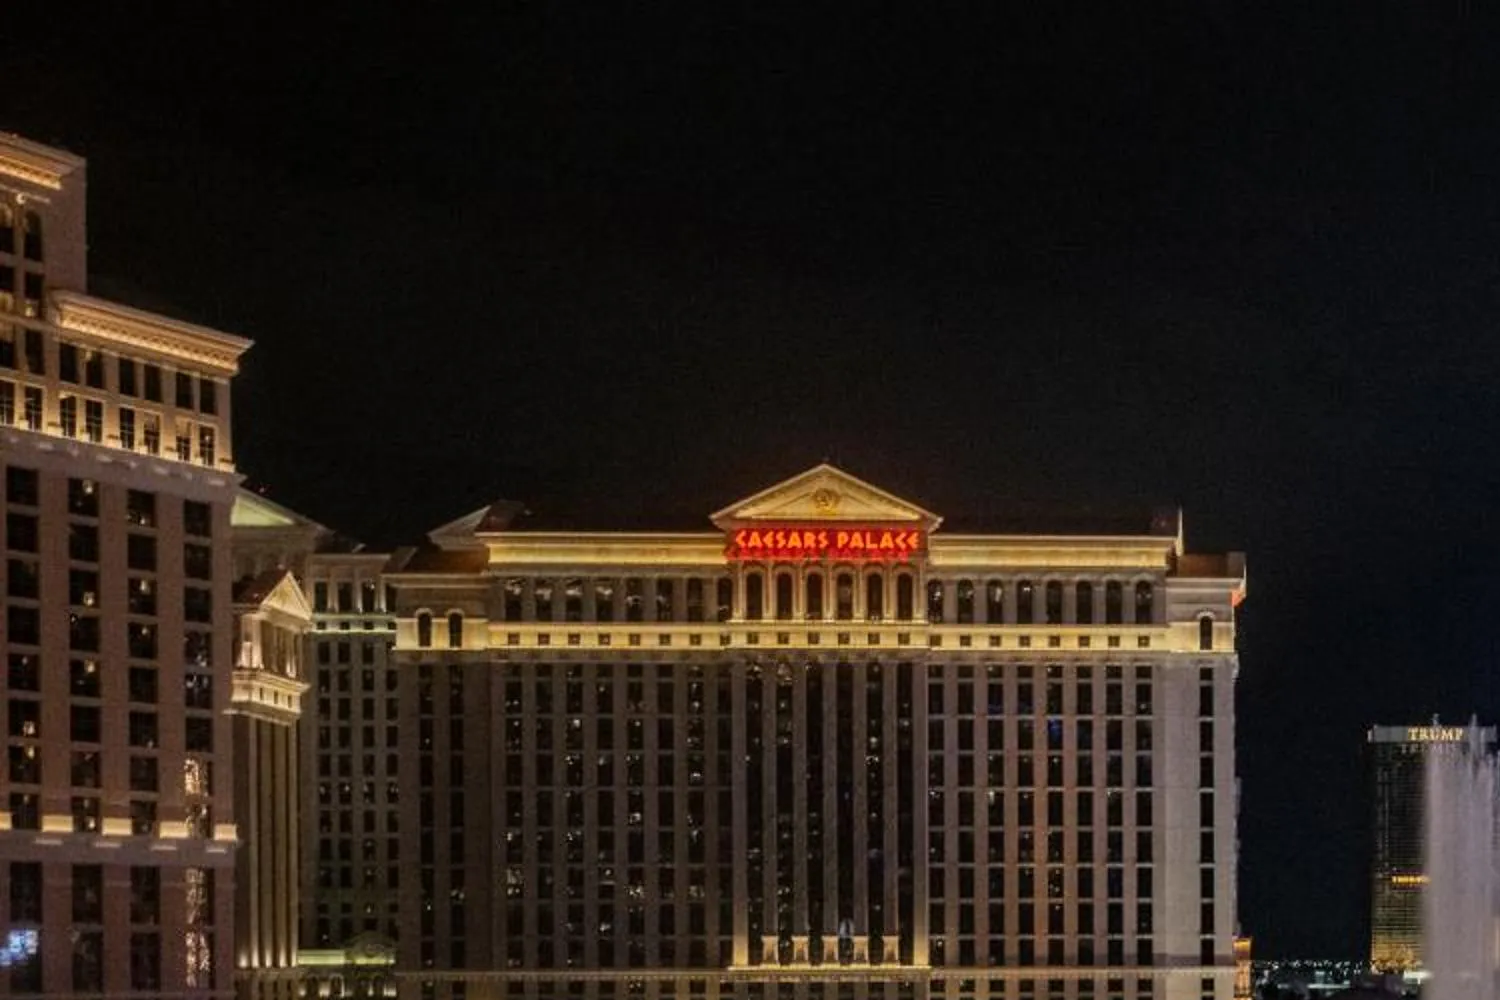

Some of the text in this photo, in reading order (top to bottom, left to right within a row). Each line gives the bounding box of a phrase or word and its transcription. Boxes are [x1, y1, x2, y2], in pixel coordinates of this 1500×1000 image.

[735, 530, 920, 549] CAESARS PALACE
[1408, 727, 1463, 741] TRUMP
